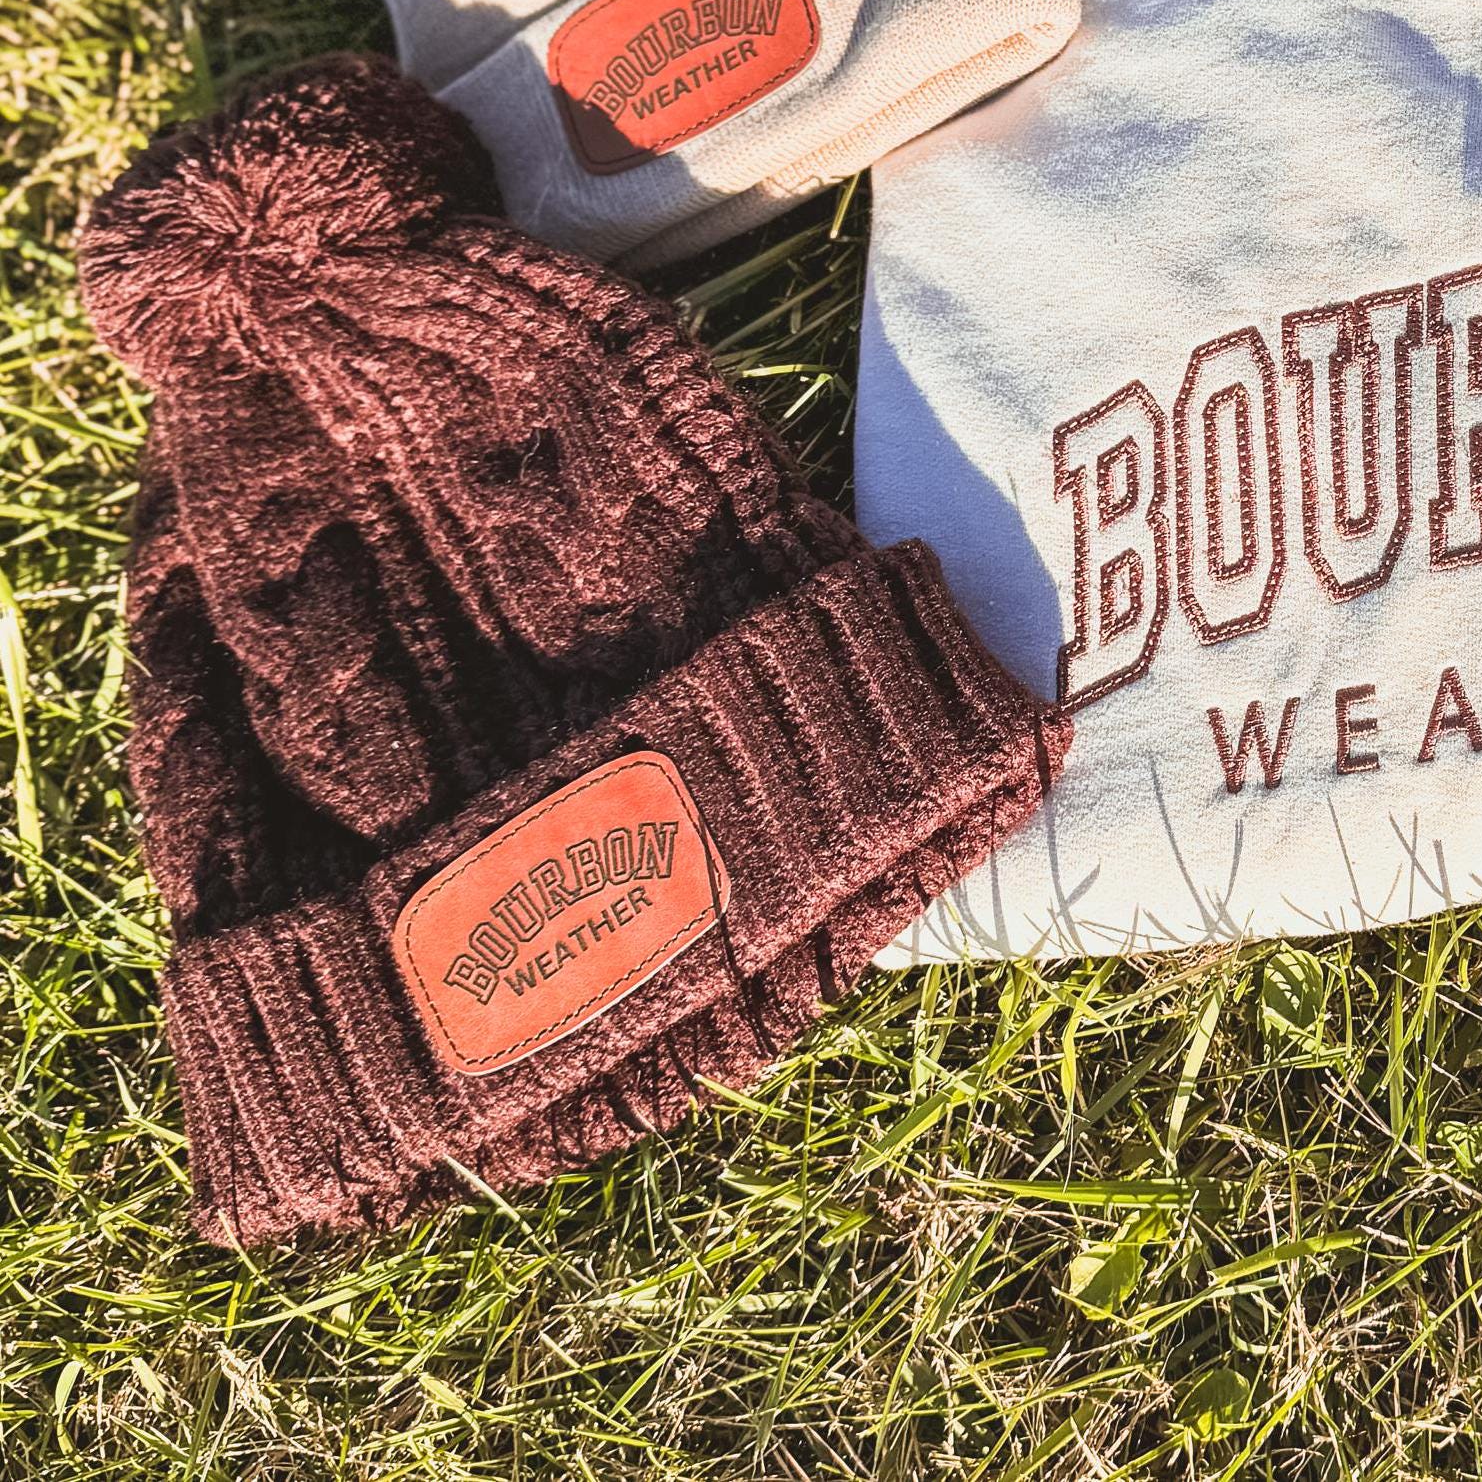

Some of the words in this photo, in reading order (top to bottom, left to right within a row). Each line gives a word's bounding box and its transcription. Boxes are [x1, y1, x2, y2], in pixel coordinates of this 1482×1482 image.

[631, 39, 759, 120] WEATHER
[443, 821, 678, 1006] BOURBON
[503, 886, 653, 997] WEATHER
